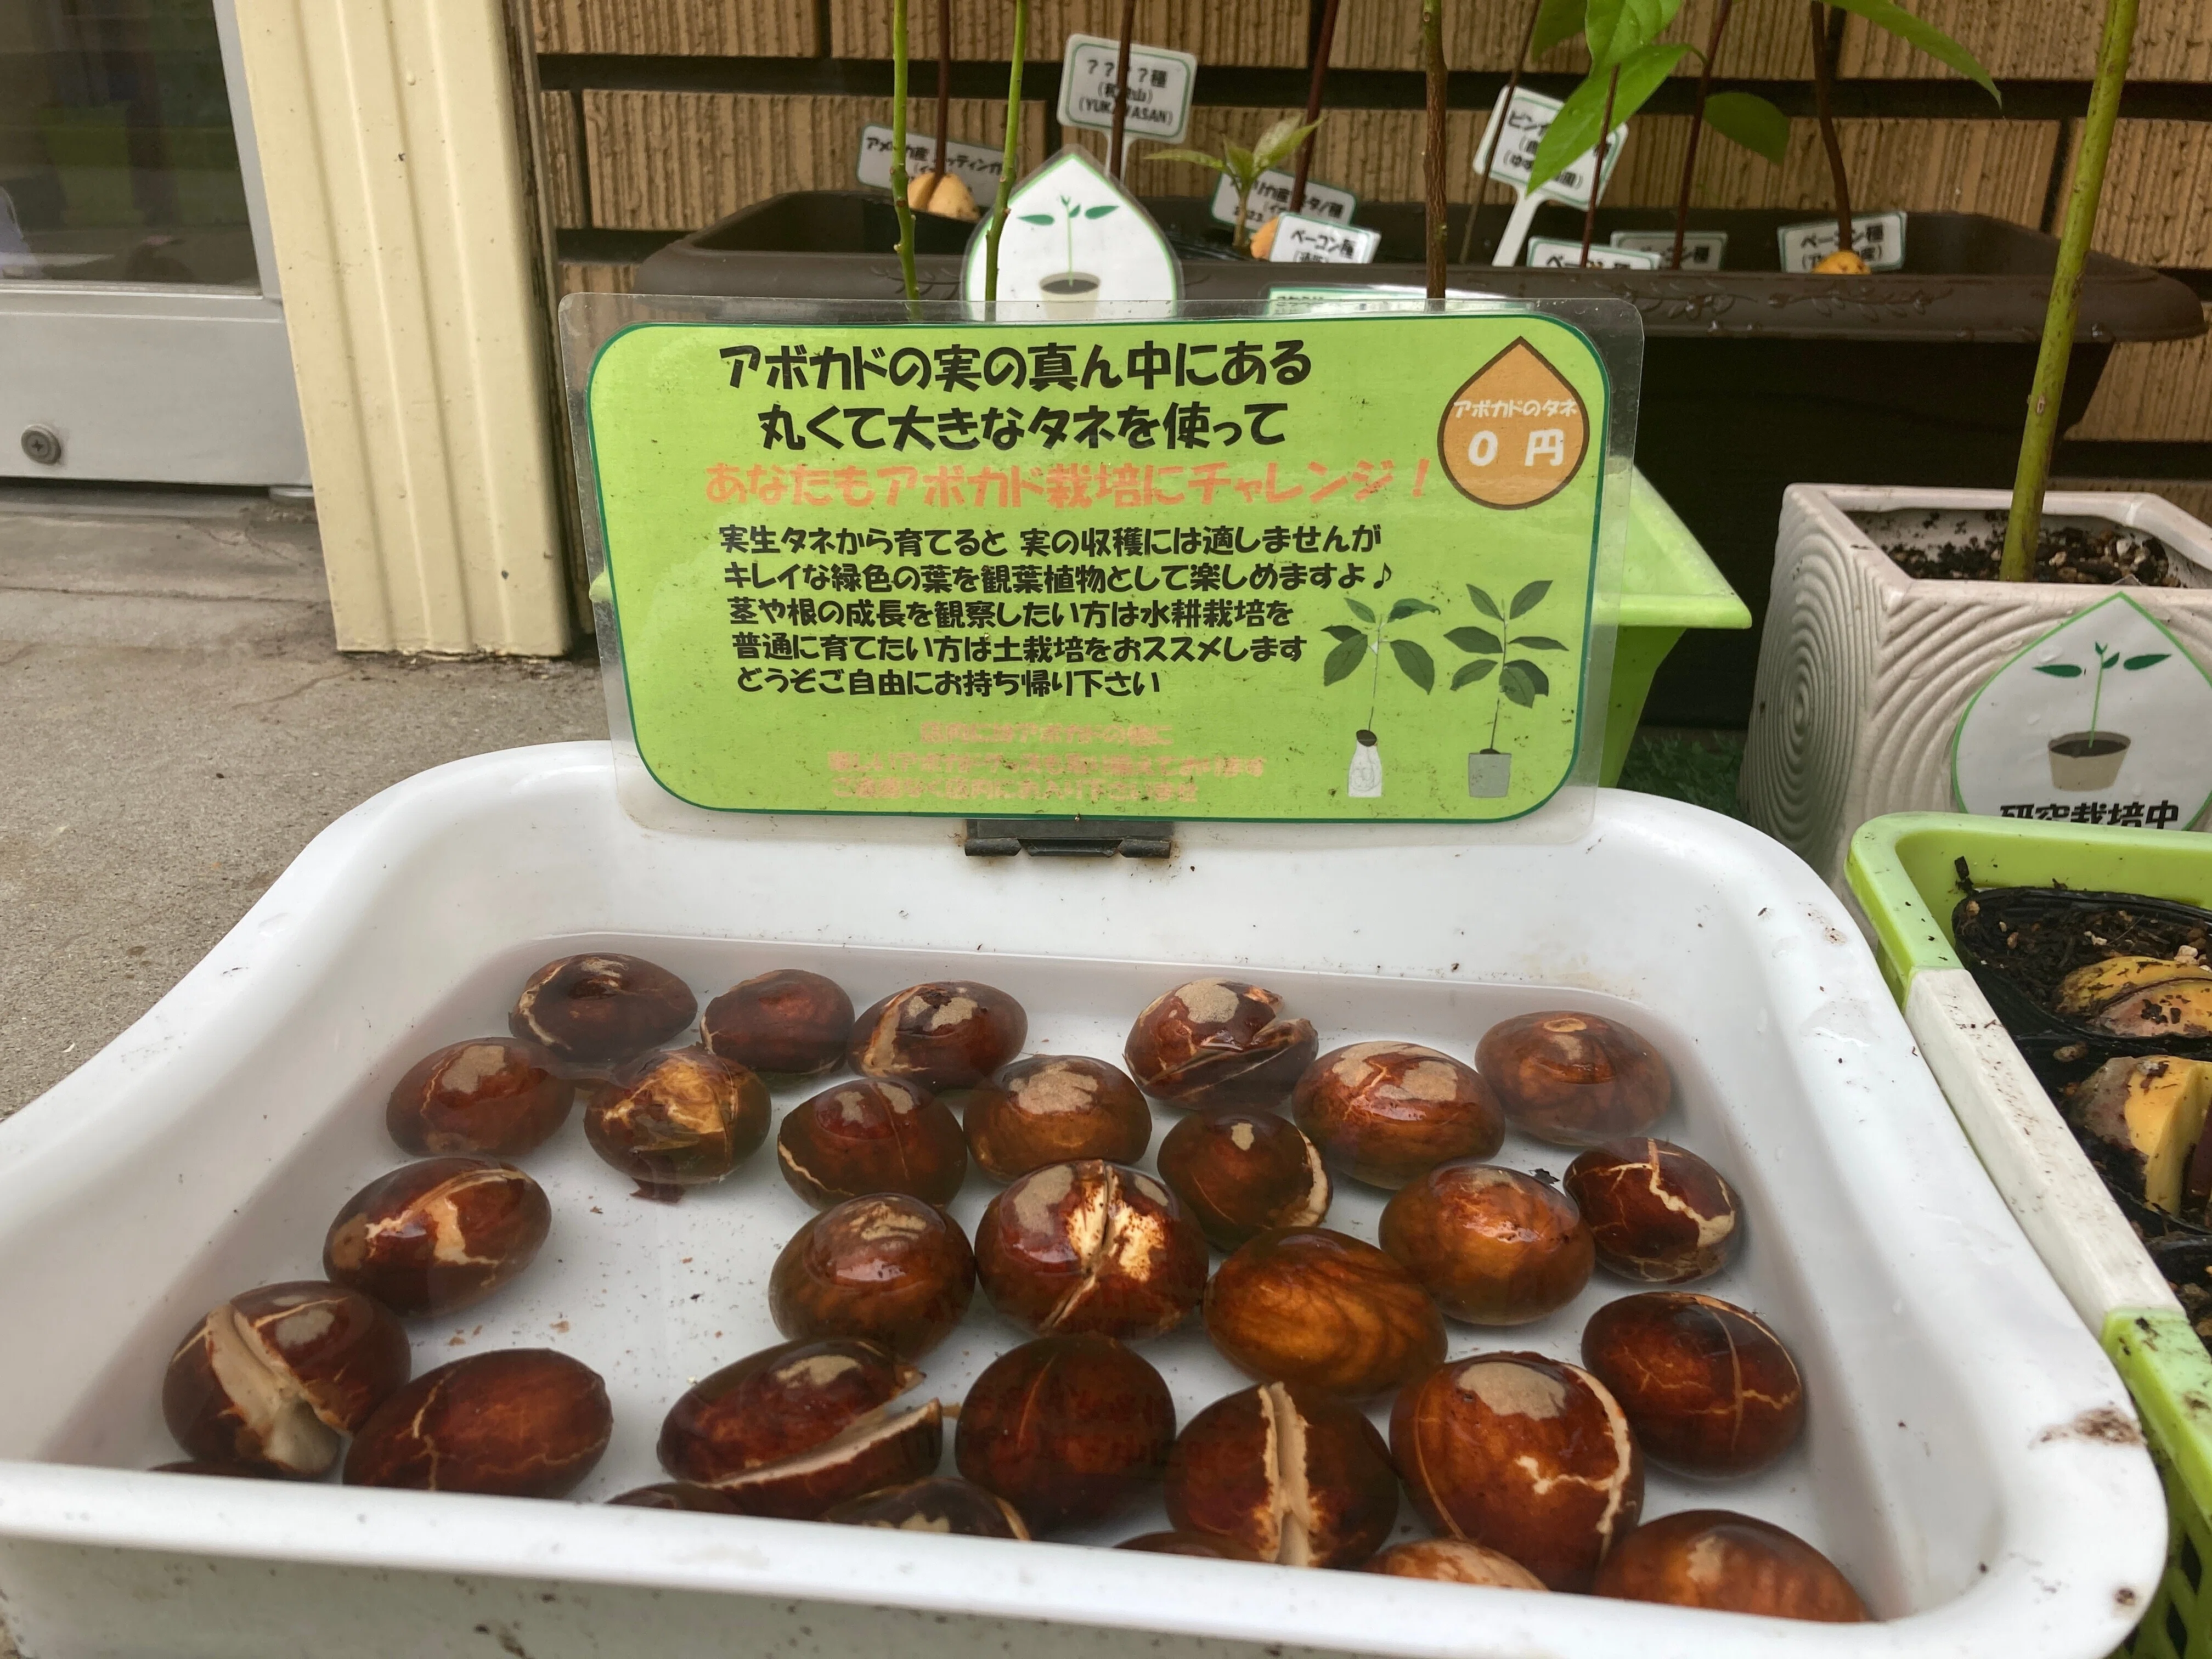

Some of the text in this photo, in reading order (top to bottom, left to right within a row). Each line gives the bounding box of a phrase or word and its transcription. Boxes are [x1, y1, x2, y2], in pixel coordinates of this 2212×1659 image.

[1088, 59, 1167, 88] ？？？種
[1801, 223, 1884, 249] ベーン種
[720, 340, 1311, 392] アボカドの実の真ん中にある
[1453, 400, 1577, 417] アボカドのタネ
[758, 402, 1288, 452] 丸くて大きなタネを使って
[1525, 428, 1564, 465] 円
[707, 460, 1429, 508] あなたもアボカド栽培にチャレンジ！
[727, 597, 1294, 628] 茎や根の成長を観察したい方は水耕栽培を
[732, 632, 1307, 663] 普通に育てたい方は土栽培をおススメします
[738, 667, 1159, 697] どうぞご自由にお持ち帰り下さい
